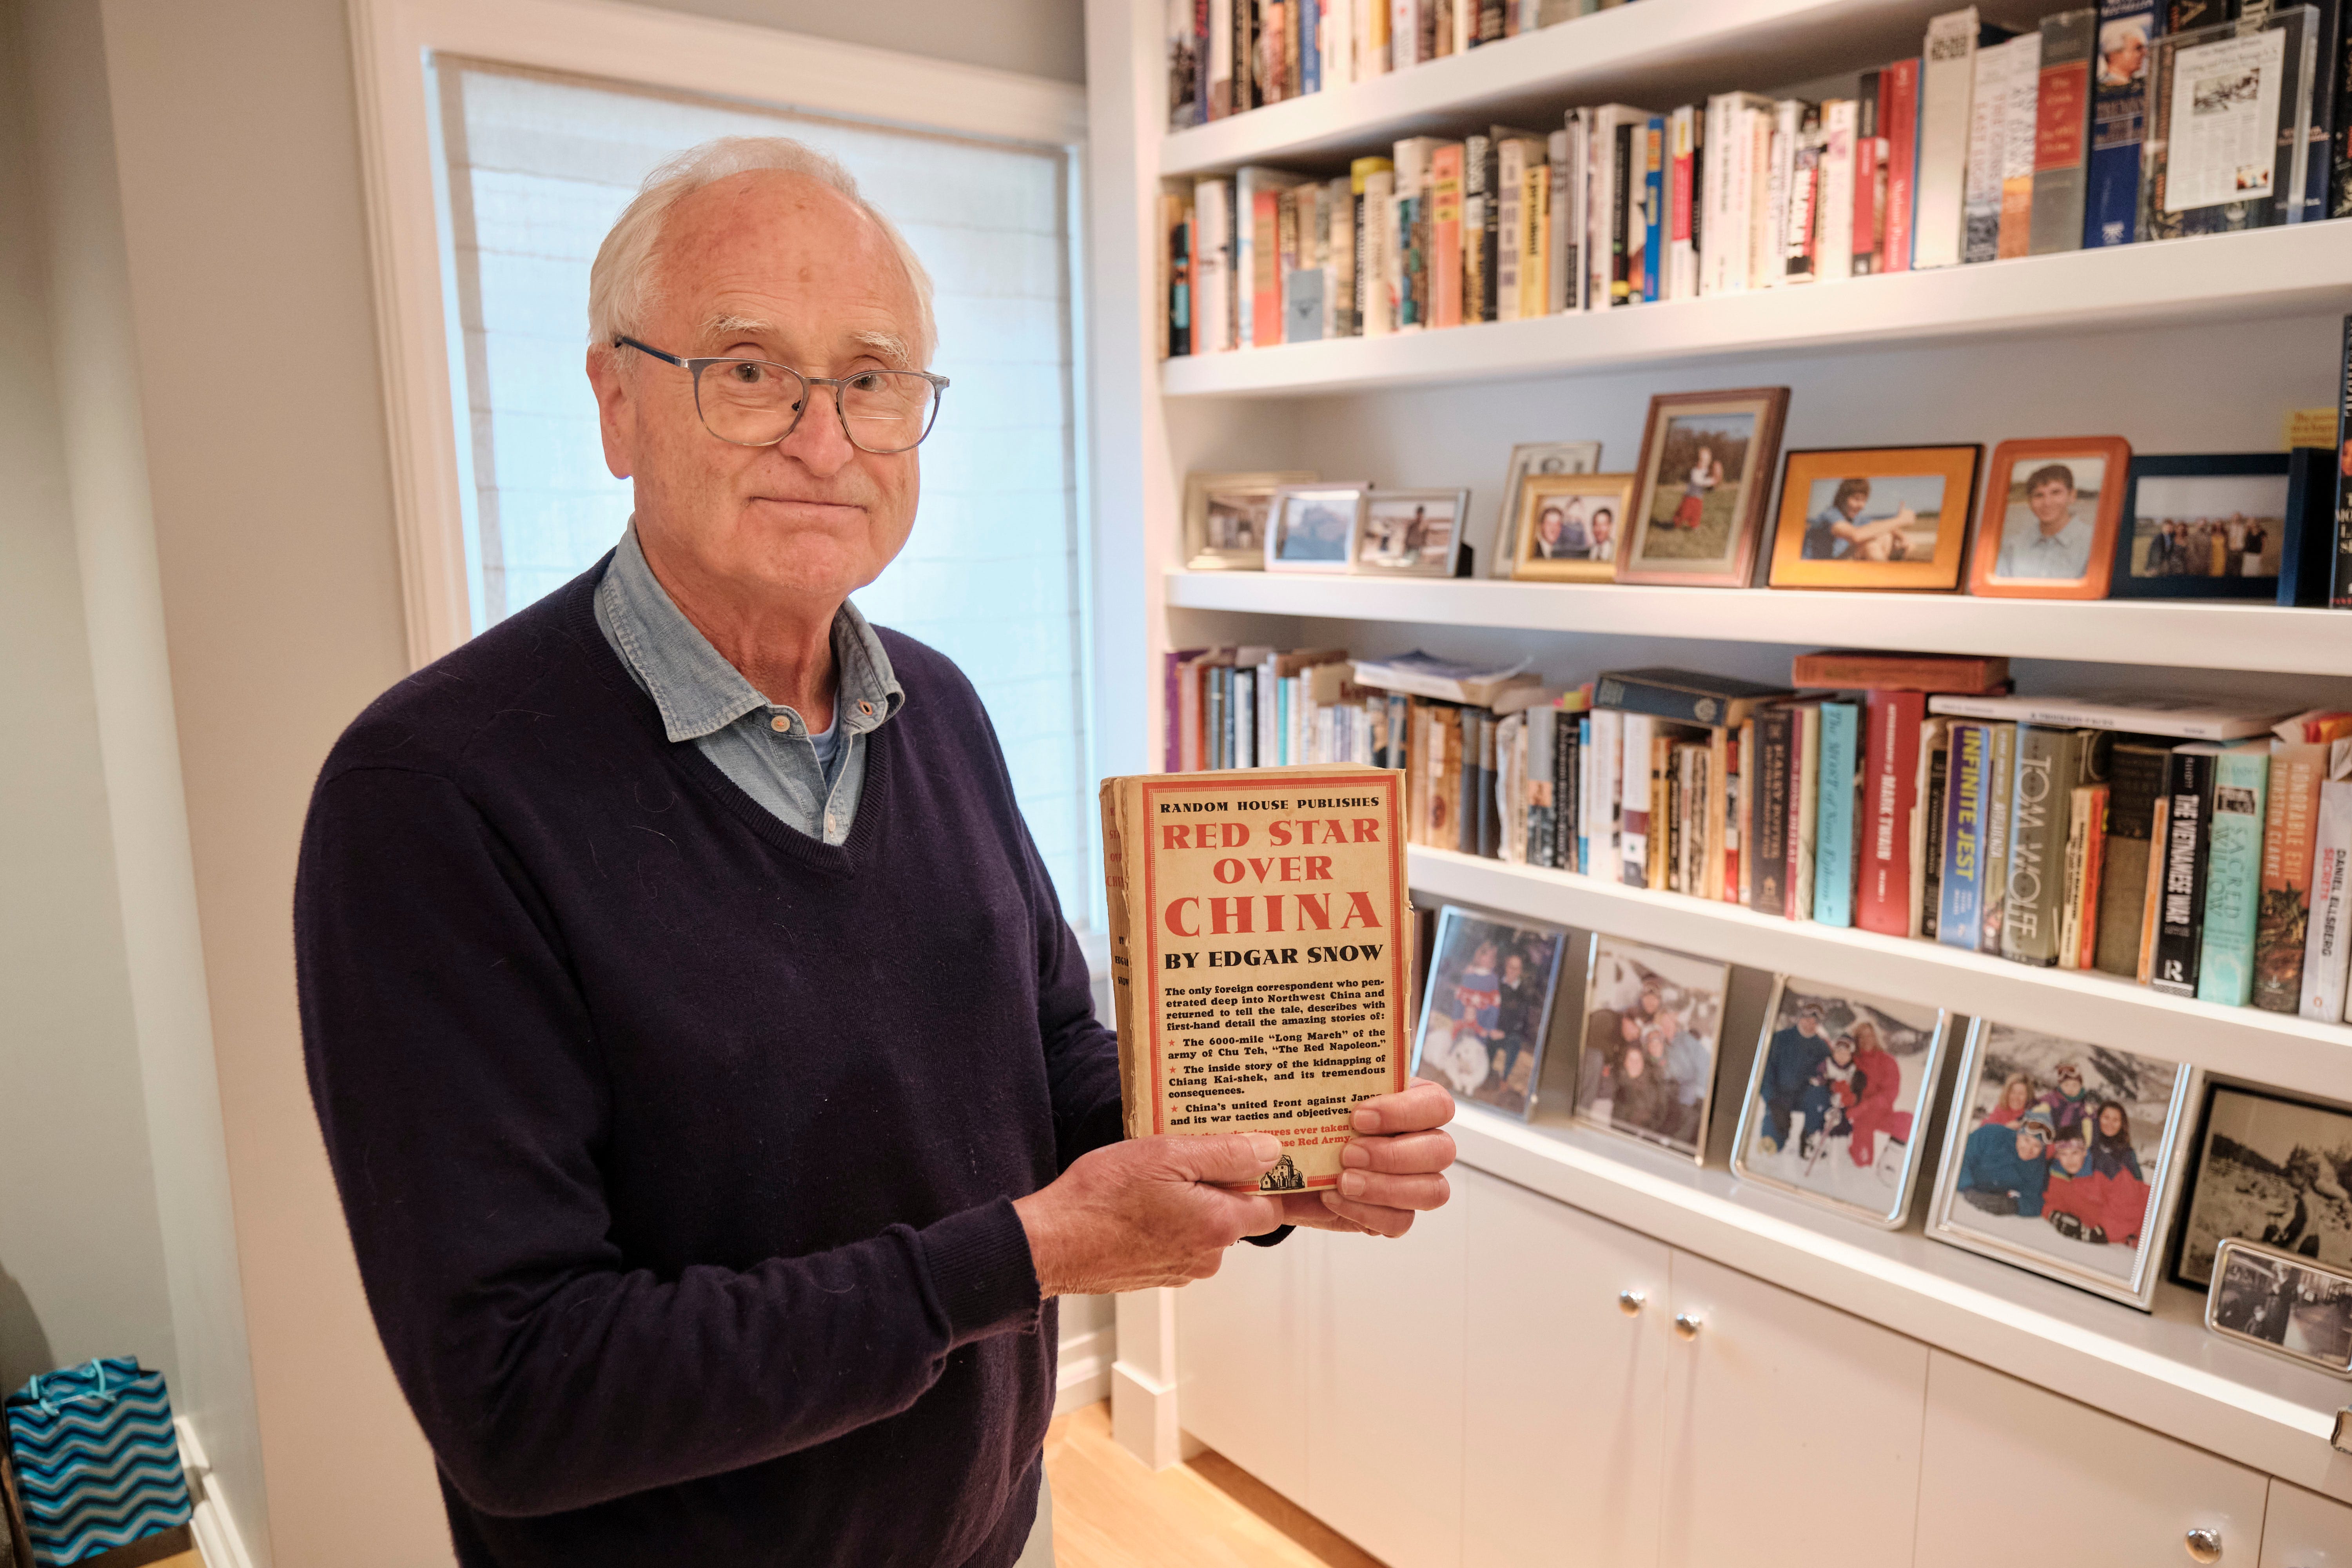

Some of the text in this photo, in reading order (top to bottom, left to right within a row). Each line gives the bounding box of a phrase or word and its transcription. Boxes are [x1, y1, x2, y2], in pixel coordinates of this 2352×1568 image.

[1160, 797, 1379, 813] RANDOM HOUSE PUBLISHES
[1879, 774, 1897, 815] MARK
[1956, 726, 1982, 881] INFINITE JEST
[2174, 794, 2199, 818] THE
[2266, 762, 2288, 878] THURSTON CLARKE
[2282, 763, 2310, 882] HONORABLE EXIT
[1162, 818, 1380, 849] RED STAR
[1877, 817, 1894, 860] TWAIN
[2005, 755, 2052, 939] TOM WOLFE
[2167, 819, 2198, 894] VIETNAMESE
[1213, 856, 1333, 884] OVER
[2209, 826, 2229, 918] WILLOW
[2223, 827, 2247, 919] SACRED
[2319, 848, 2334, 901] SECRETS
[1165, 891, 1382, 937] CHINA
[2165, 895, 2190, 925] WAR
[2321, 849, 2346, 957] DANIEL ELLSBERG
[1119, 936, 1124, 945] BY
[1165, 944, 1383, 969] BY EDGAR SNOW
[1165, 987, 1185, 996] The
[1189, 986, 1212, 996] only
[1215, 984, 1254, 994] foreign
[1256, 981, 1333, 992] correspondent
[1361, 979, 1384, 988] pen-
[1166, 989, 1385, 1007] etrated deep into Northwest China and
[1166, 1009, 1214, 1019] returned
[1235, 1007, 1253, 1016] tell
[1258, 1007, 1275, 1015] the
[1281, 1005, 1303, 1014] tale,
[1307, 1003, 1357, 1012] describes
[1362, 1000, 1385, 1009] with
[1167, 1020, 1220, 1031] first-hand
[1225, 1019, 1255, 1028] detail
[1260, 1018, 1277, 1026] the
[1281, 1015, 1326, 1025] amazing
[1331, 1013, 1365, 1022] stories
[1183, 1038, 1204, 1047] The
[1209, 1035, 1264, 1045] 6000-mile
[1353, 1029, 1364, 1038] of
[1368, 1029, 1385, 1037] the
[1202, 1049, 1213, 1057] of
[1244, 1047, 1267, 1055] Teh,
[1303, 1043, 1324, 1052] Red
[1169, 1078, 1207, 1086] Chiang
[1214, 1073, 1267, 1083] Kai-shek,
[1274, 1071, 1294, 1080] and
[1321, 1067, 1385, 1078] tremendous
[1183, 1065, 1204, 1074] The
[1208, 1063, 1240, 1073] inside
[1277, 1060, 1288, 1069] of
[1313, 1056, 1372, 1067] kidnapping
[1168, 1088, 1245, 1098] consequences.
[1232, 1100, 1267, 1109] united
[1273, 1099, 1301, 1107] front
[1307, 1096, 1346, 1107] against
[1171, 1116, 1190, 1125] and
[1194, 1116, 1207, 1124] its
[1235, 1112, 1269, 1121] tactics
[1273, 1110, 1293, 1119] and
[1297, 1107, 1352, 1118] objectives.
[1321, 1124, 1349, 1133] taken
[1298, 1137, 1318, 1146] Red
